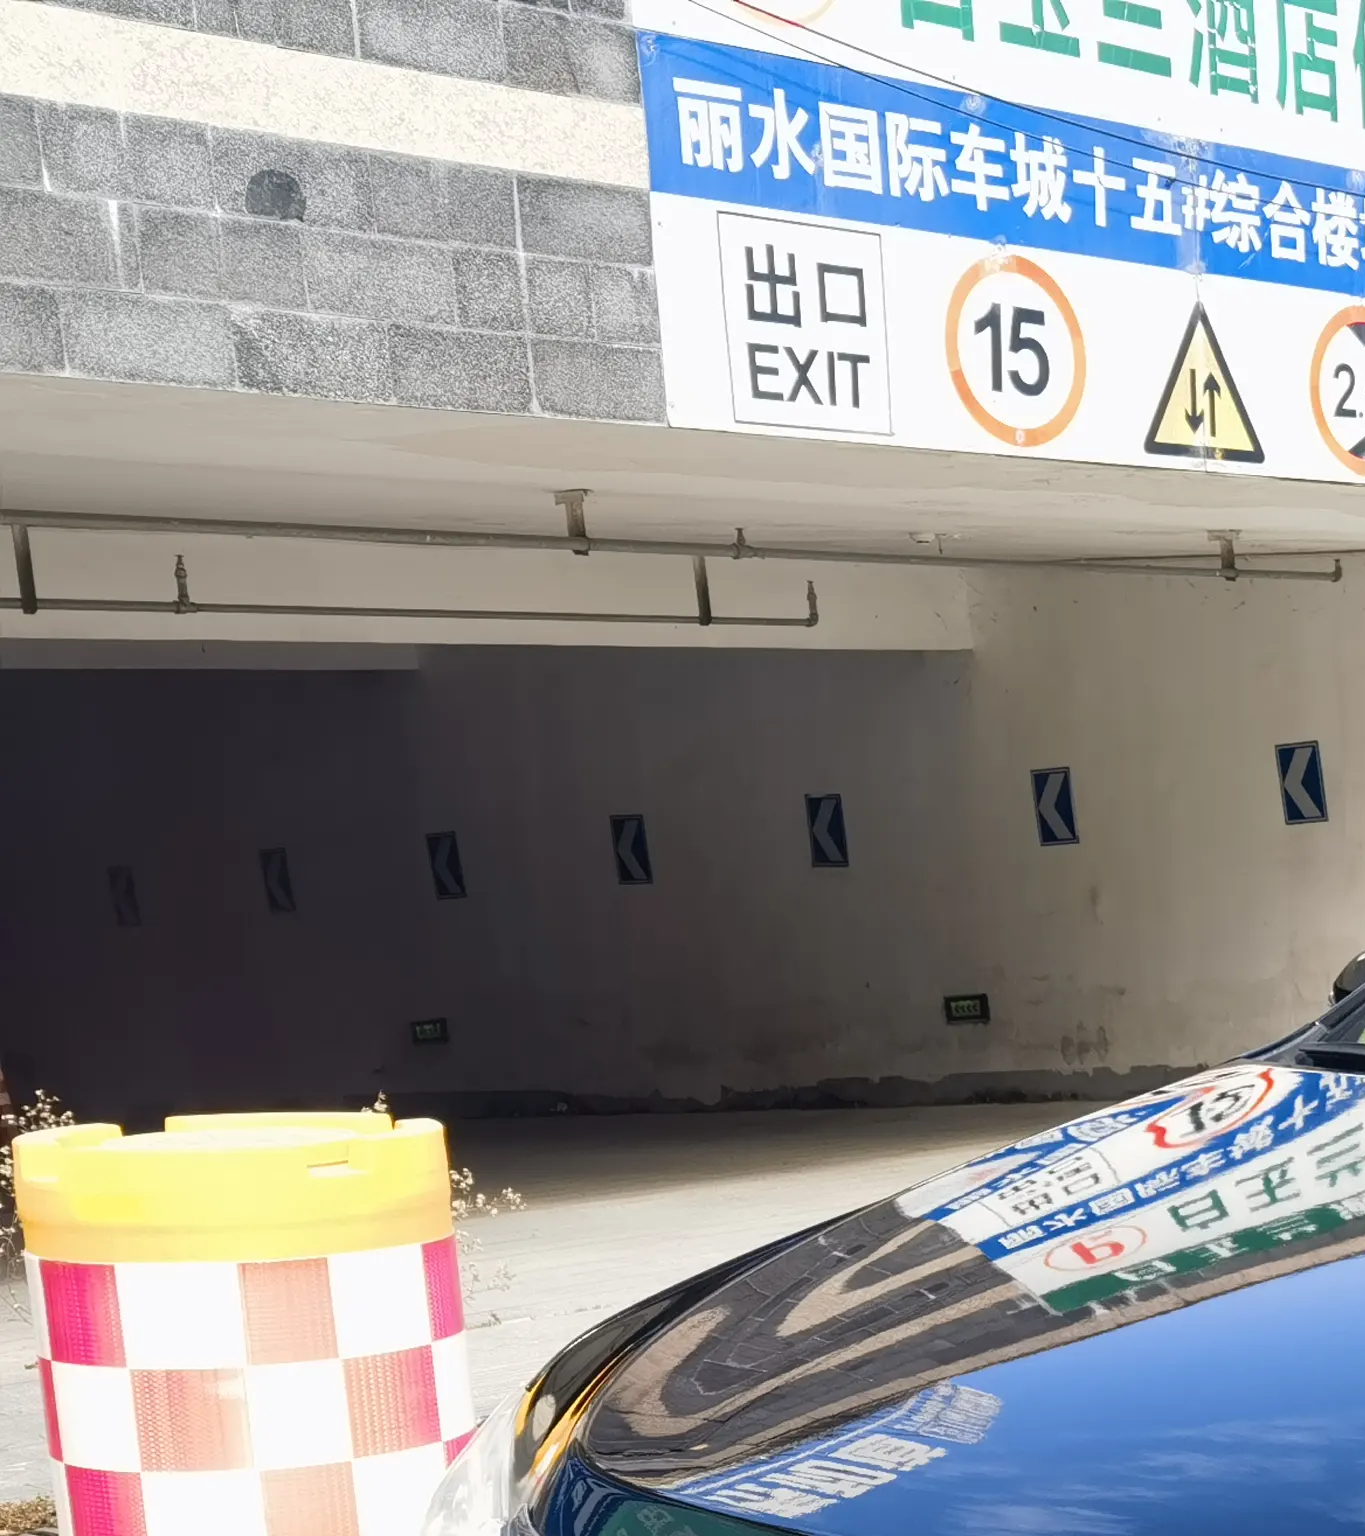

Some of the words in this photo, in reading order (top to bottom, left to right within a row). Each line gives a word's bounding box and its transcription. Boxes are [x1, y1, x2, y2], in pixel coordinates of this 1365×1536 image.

[744, 243, 867, 328] 出口
[746, 342, 870, 409] EXIT
[973, 302, 1050, 397] 15
